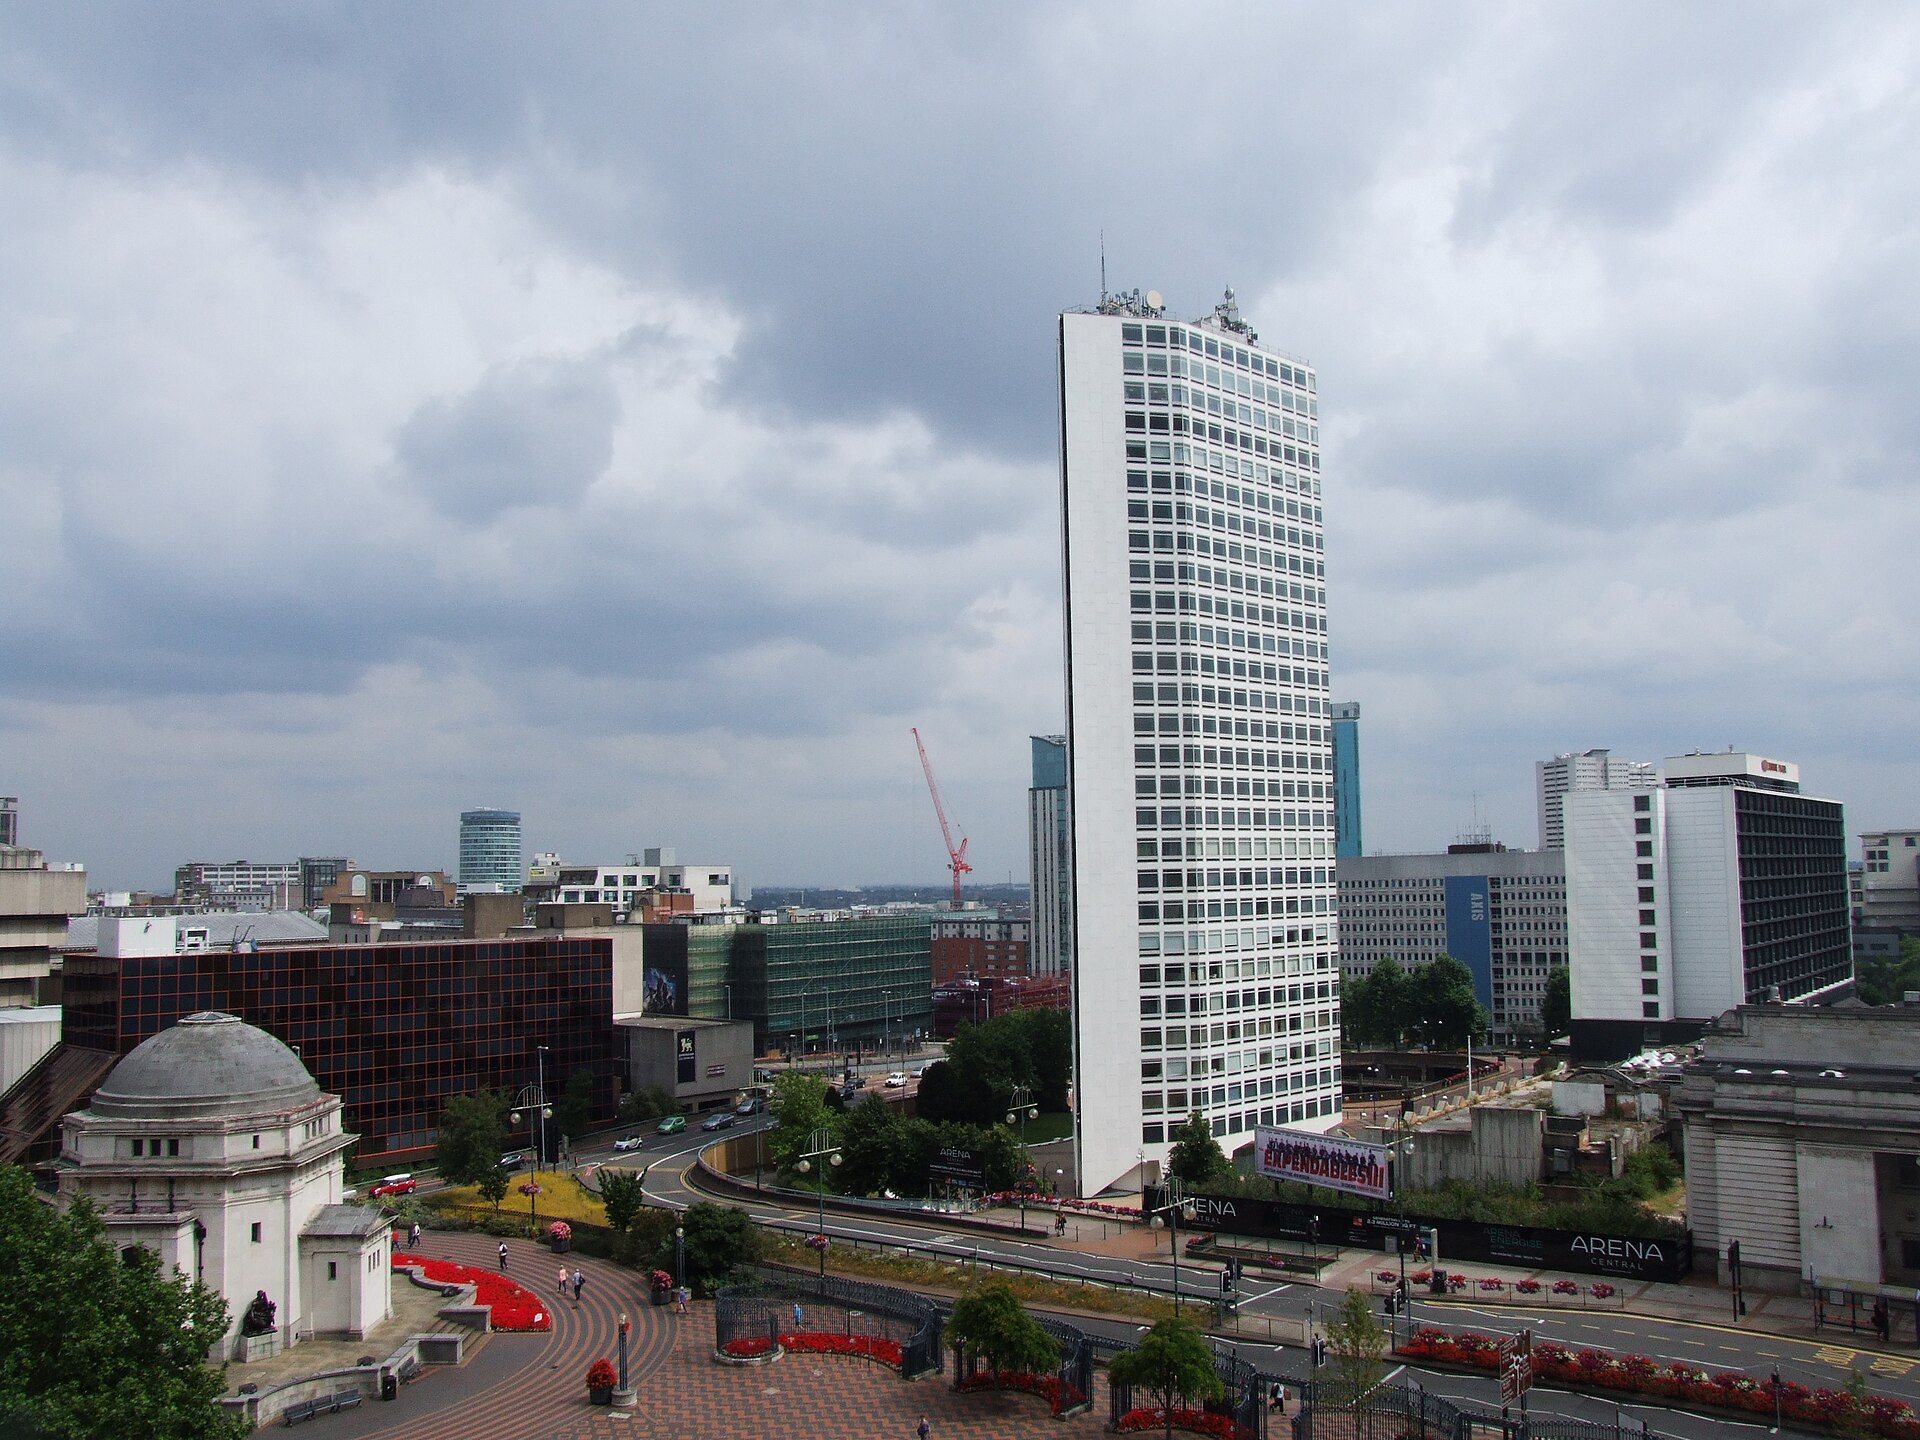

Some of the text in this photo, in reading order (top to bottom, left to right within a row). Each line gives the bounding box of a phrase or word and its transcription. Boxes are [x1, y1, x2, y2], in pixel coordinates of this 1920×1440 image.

[1471, 893, 1484, 920] AXIS
[940, 1148, 971, 1159] ARENA
[1376, 1219, 1399, 1227] MILLION
[1490, 1236, 1543, 1249] ENERGISE
[1571, 1235, 1664, 1262] ARENA
[1590, 1257, 1644, 1271] CENTRAL
